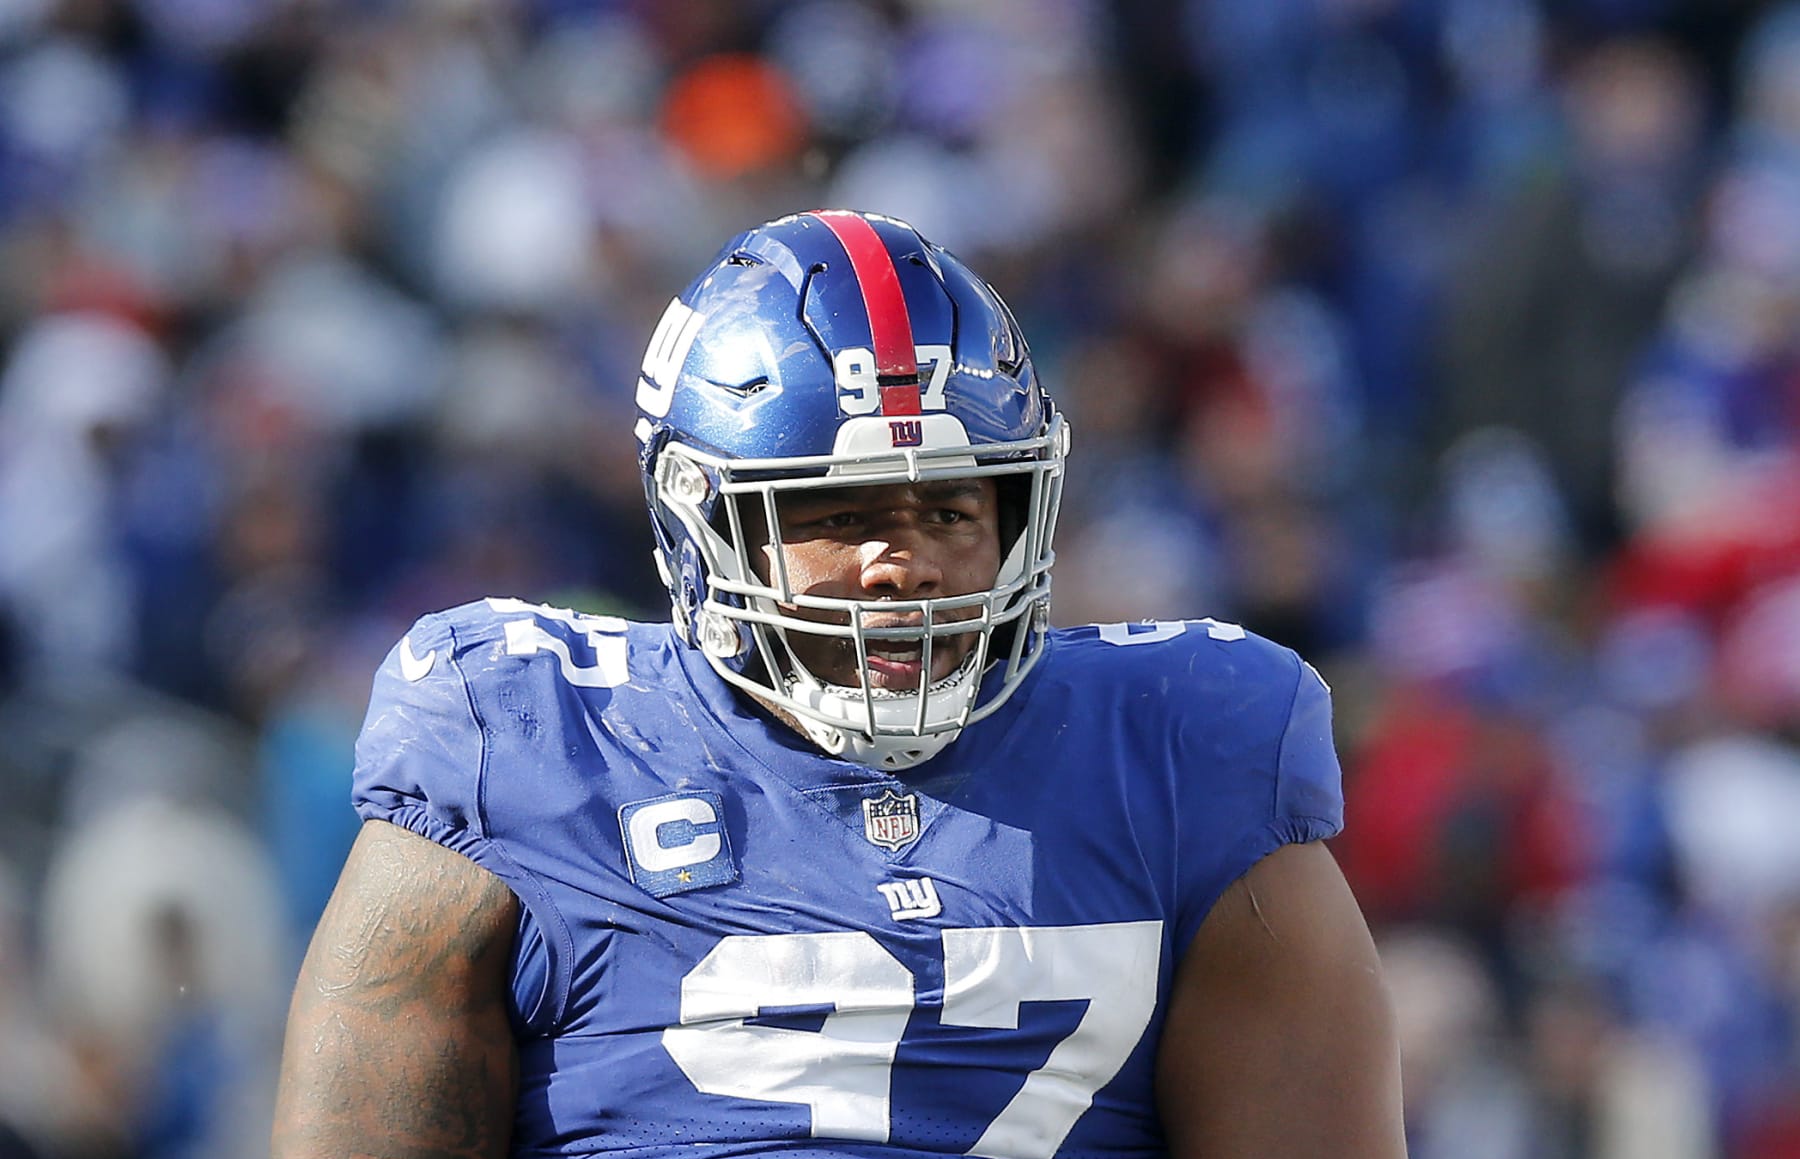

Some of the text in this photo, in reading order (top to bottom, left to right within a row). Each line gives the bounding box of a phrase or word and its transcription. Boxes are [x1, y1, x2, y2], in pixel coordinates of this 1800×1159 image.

[835, 345, 953, 415] 97
[629, 798, 721, 872] C
[875, 815, 911, 840] NFL
